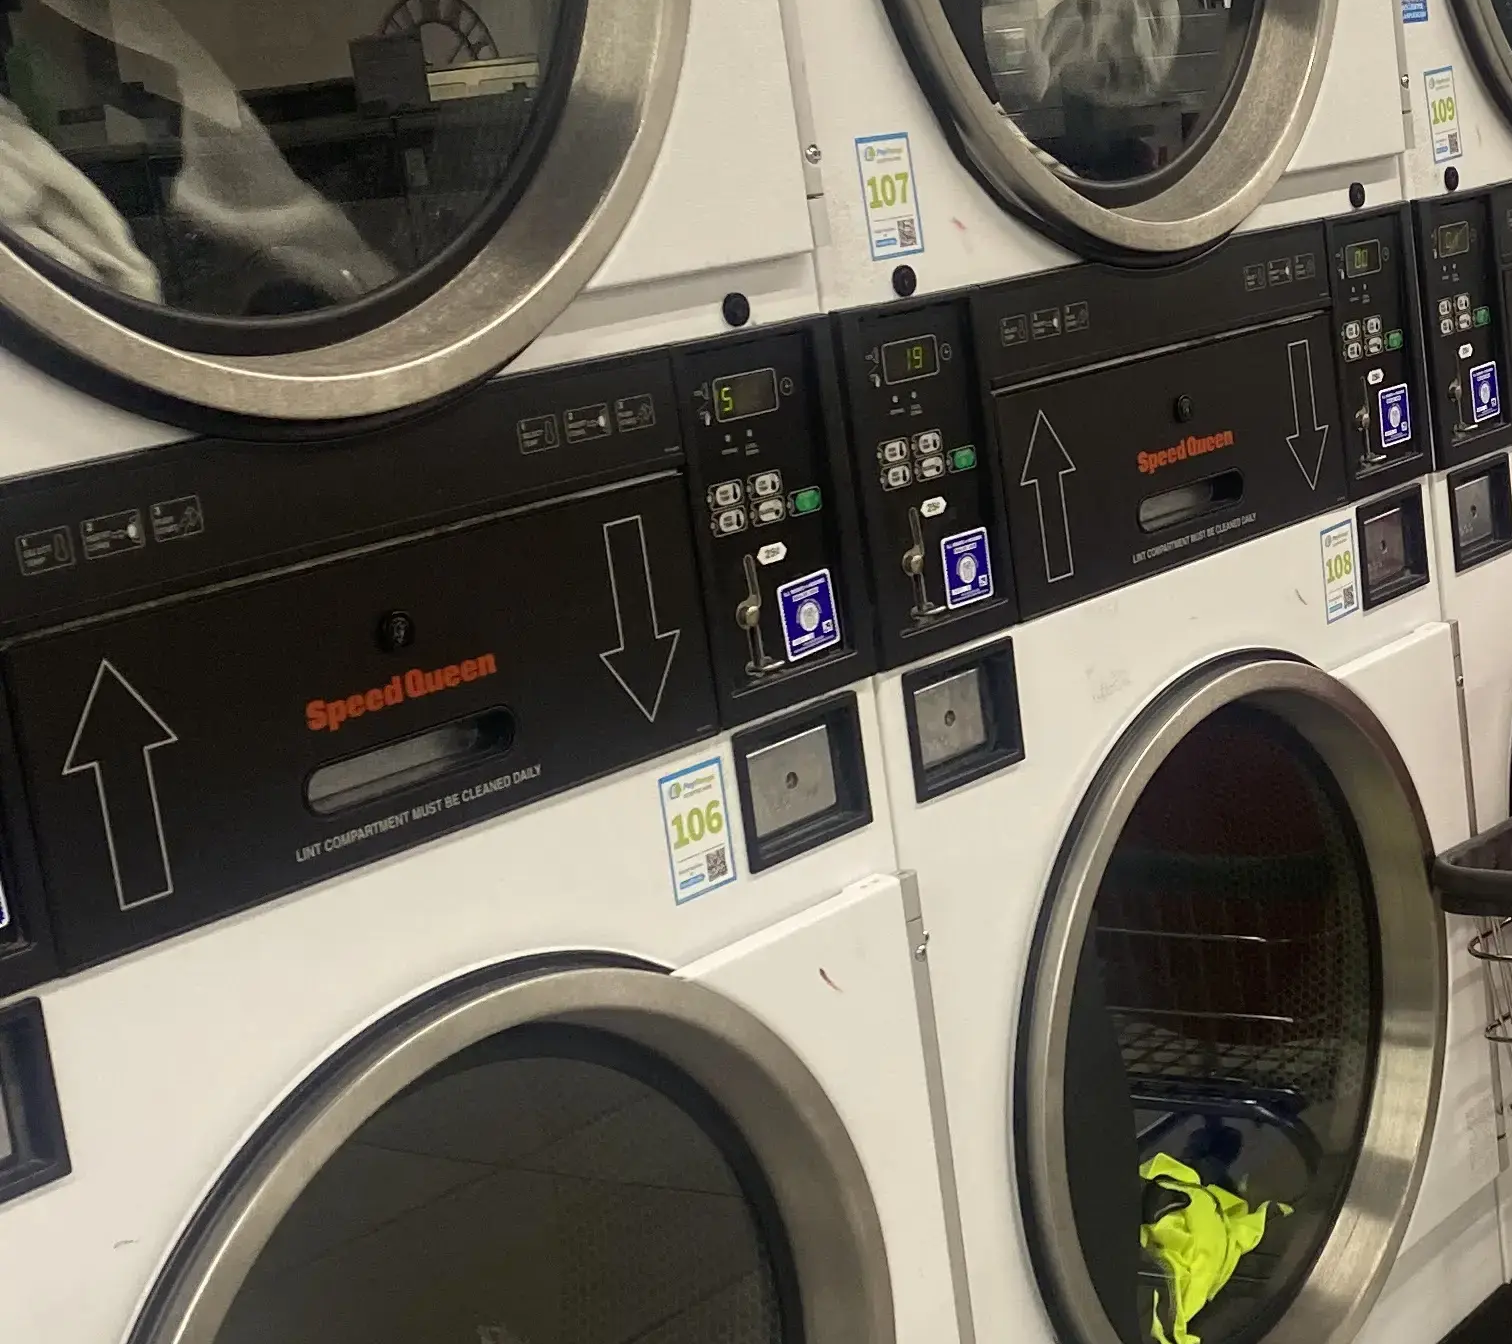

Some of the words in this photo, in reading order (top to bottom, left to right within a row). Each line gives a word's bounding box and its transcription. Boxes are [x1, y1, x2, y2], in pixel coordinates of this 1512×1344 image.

[1431, 96, 1455, 125] 109
[866, 171, 909, 209] 107
[906, 346, 923, 371] 19
[720, 386, 733, 412] 5
[1136, 439, 1188, 475] Speed
[1186, 430, 1235, 457] Queen
[1326, 549, 1352, 584] 108
[304, 674, 404, 732] Speed
[403, 653, 498, 699] Queen
[296, 842, 323, 863] LINT
[323, 810, 410, 853] COMPARTMENT
[411, 798, 443, 821] MUST
[443, 792, 461, 810] BE
[461, 773, 512, 803] CLEANED
[511, 763, 542, 787] DAILY
[671, 799, 724, 850] 106
